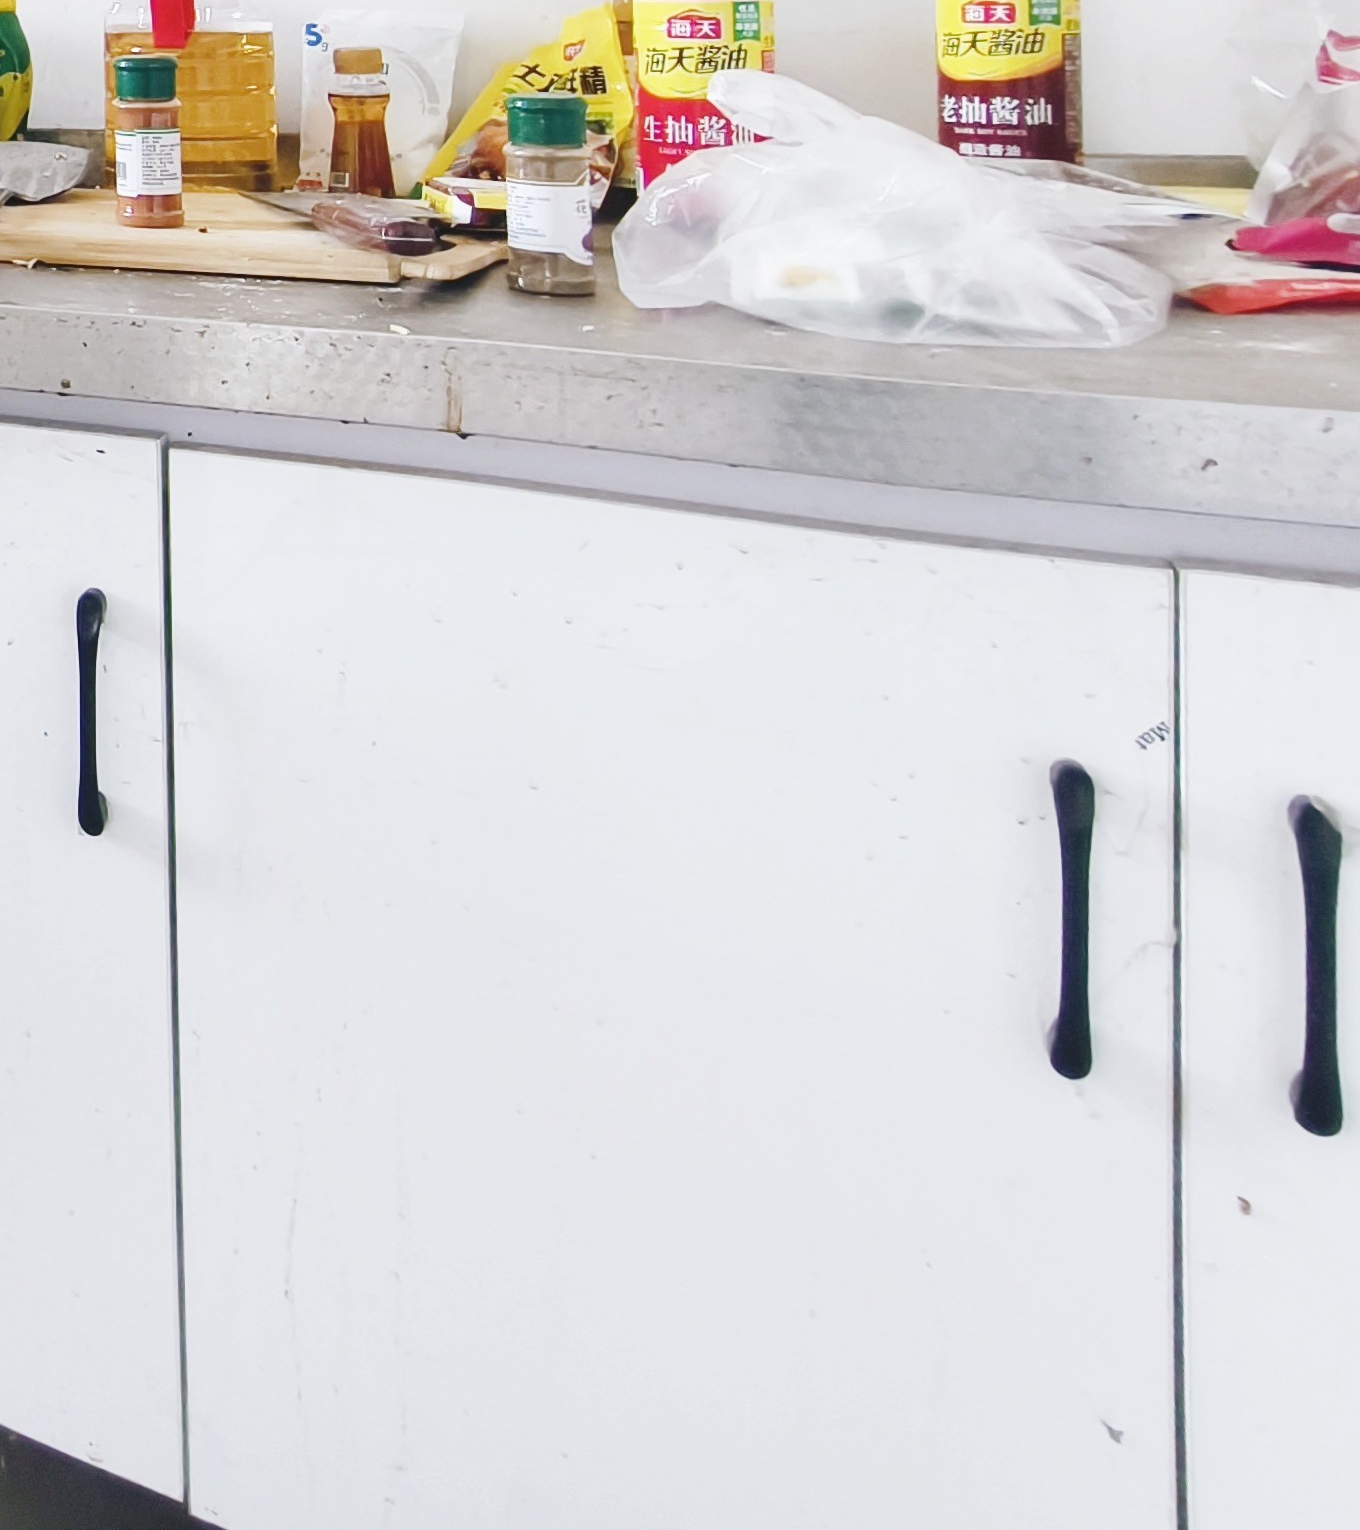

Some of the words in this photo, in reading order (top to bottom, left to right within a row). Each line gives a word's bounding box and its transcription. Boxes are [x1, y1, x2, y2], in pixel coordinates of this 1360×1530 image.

[671, 19, 716, 37] 海天
[964, 5, 1011, 22] 海天
[942, 27, 1046, 57] 海天酱油
[645, 43, 748, 74] 海天酱油
[941, 94, 1053, 125] 老抽酱油
